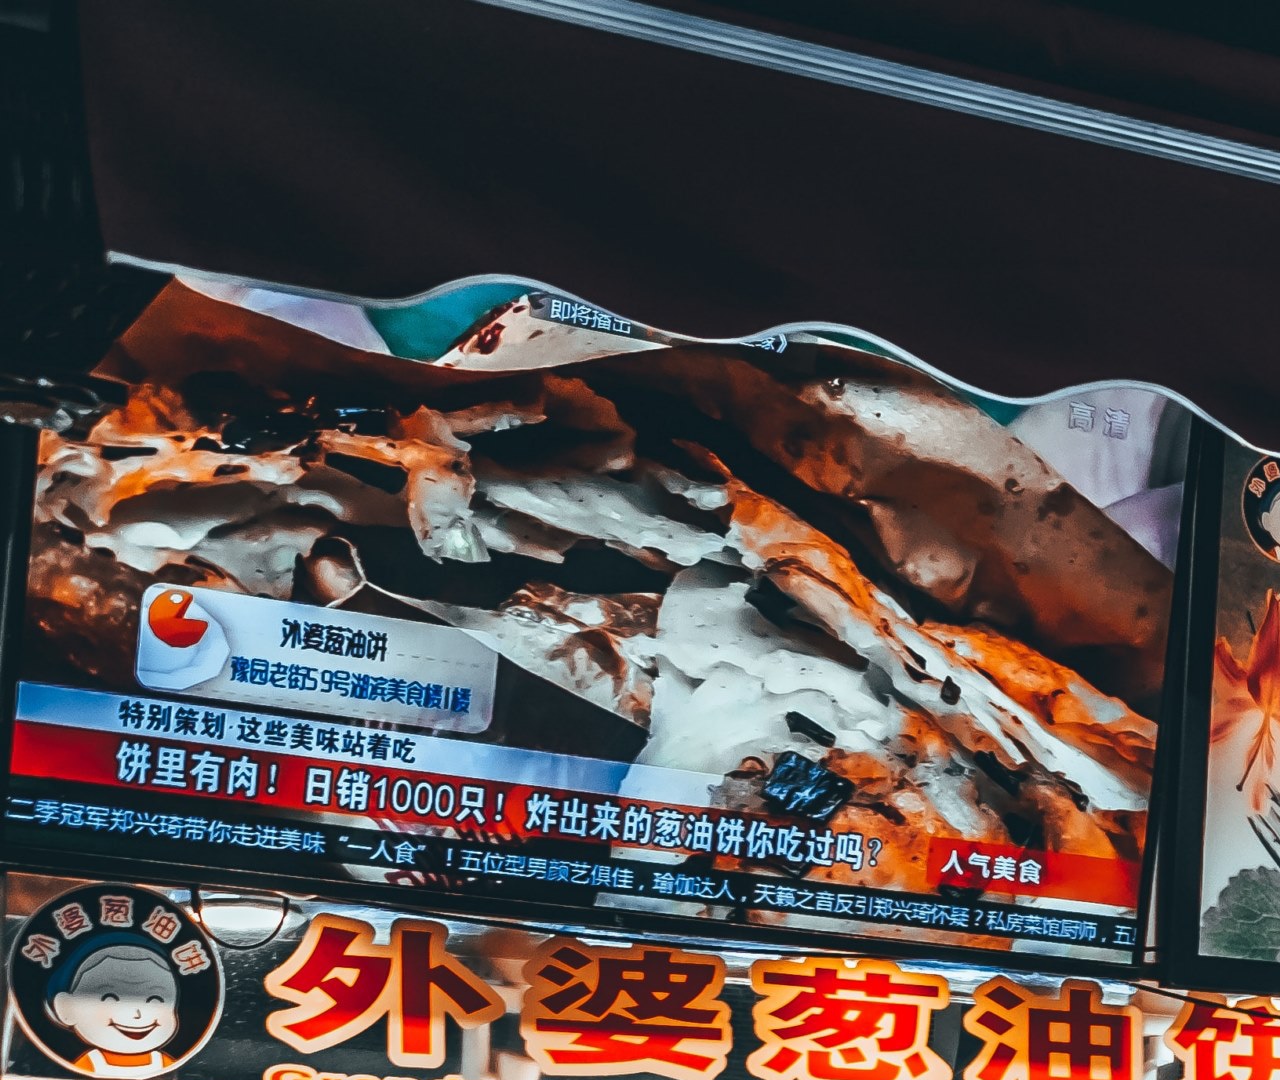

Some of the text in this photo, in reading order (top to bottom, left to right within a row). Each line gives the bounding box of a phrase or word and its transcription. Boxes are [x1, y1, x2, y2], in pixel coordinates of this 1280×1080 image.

[1068, 401, 1131, 440] 高清
[941, 849, 1042, 885] 人气美食
